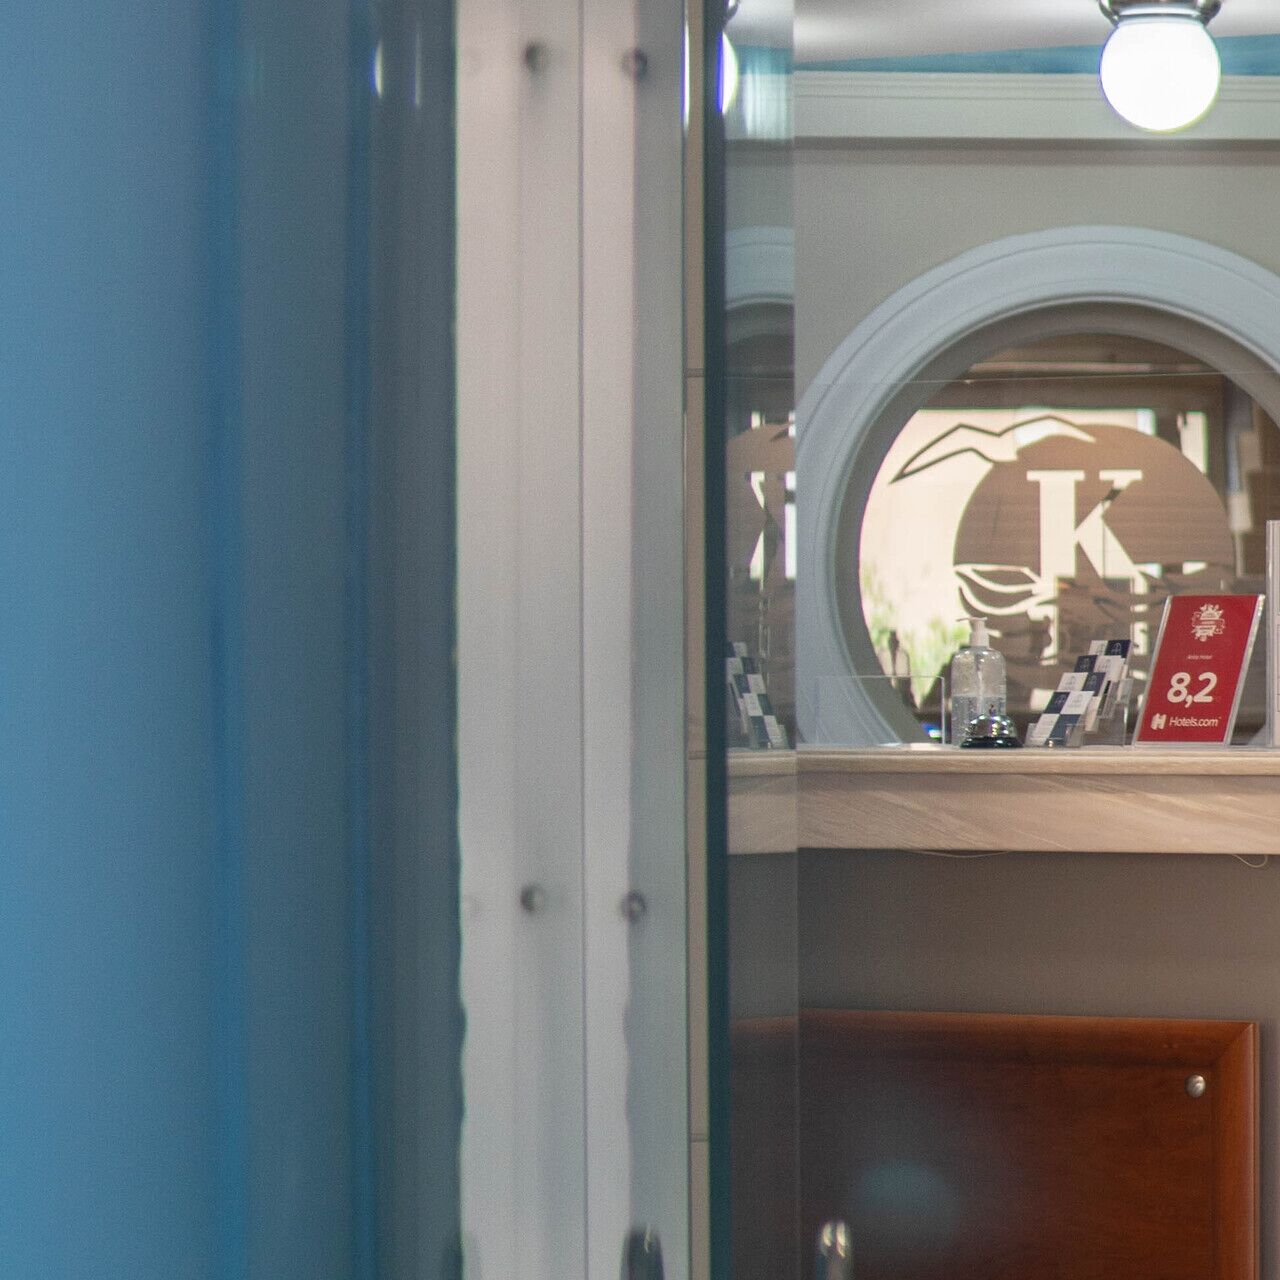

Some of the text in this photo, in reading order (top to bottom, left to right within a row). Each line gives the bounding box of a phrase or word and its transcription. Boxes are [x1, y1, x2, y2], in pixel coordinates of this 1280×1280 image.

[1027, 470, 1142, 579] K
[1167, 671, 1218, 708] 8,2
[1169, 716, 1219, 728] Hotels.com
